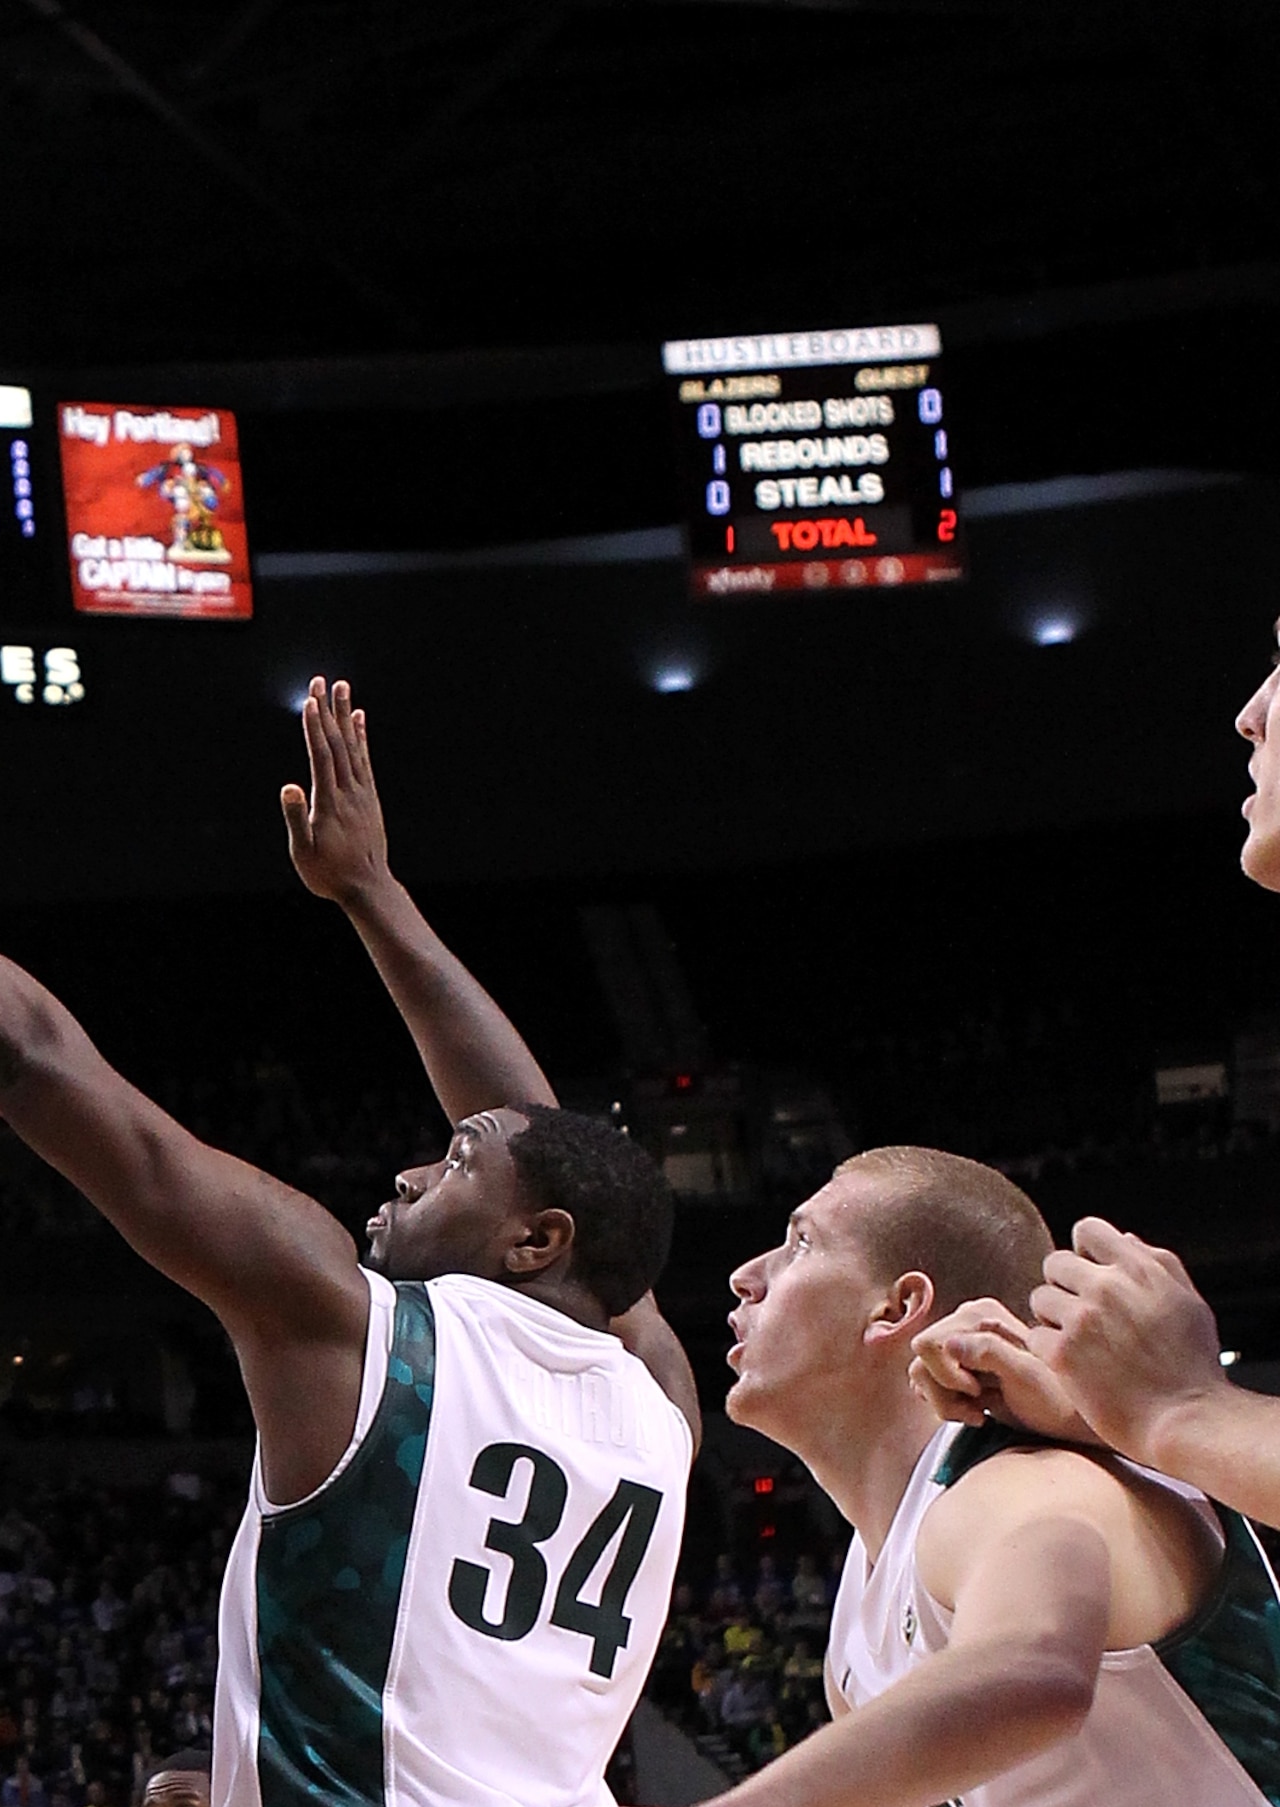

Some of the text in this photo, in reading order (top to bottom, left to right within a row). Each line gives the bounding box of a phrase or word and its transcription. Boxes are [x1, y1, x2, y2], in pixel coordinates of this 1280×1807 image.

[685, 329, 919, 363] HUSTLEBOARD
[679, 373, 782, 404] BLAZERS
[854, 364, 930, 393] GUEST
[697, 403, 721, 439] 0
[724, 395, 895, 435] BLOCKED SHOTS
[918, 388, 943, 425] 0
[739, 433, 890, 472] REBOUNDS
[706, 479, 731, 515] 0
[755, 472, 884, 511] STEALS
[771, 518, 878, 551] TOTAL
[79, 559, 178, 592] CAPTAIN
[448, 1441, 665, 1681] 34
